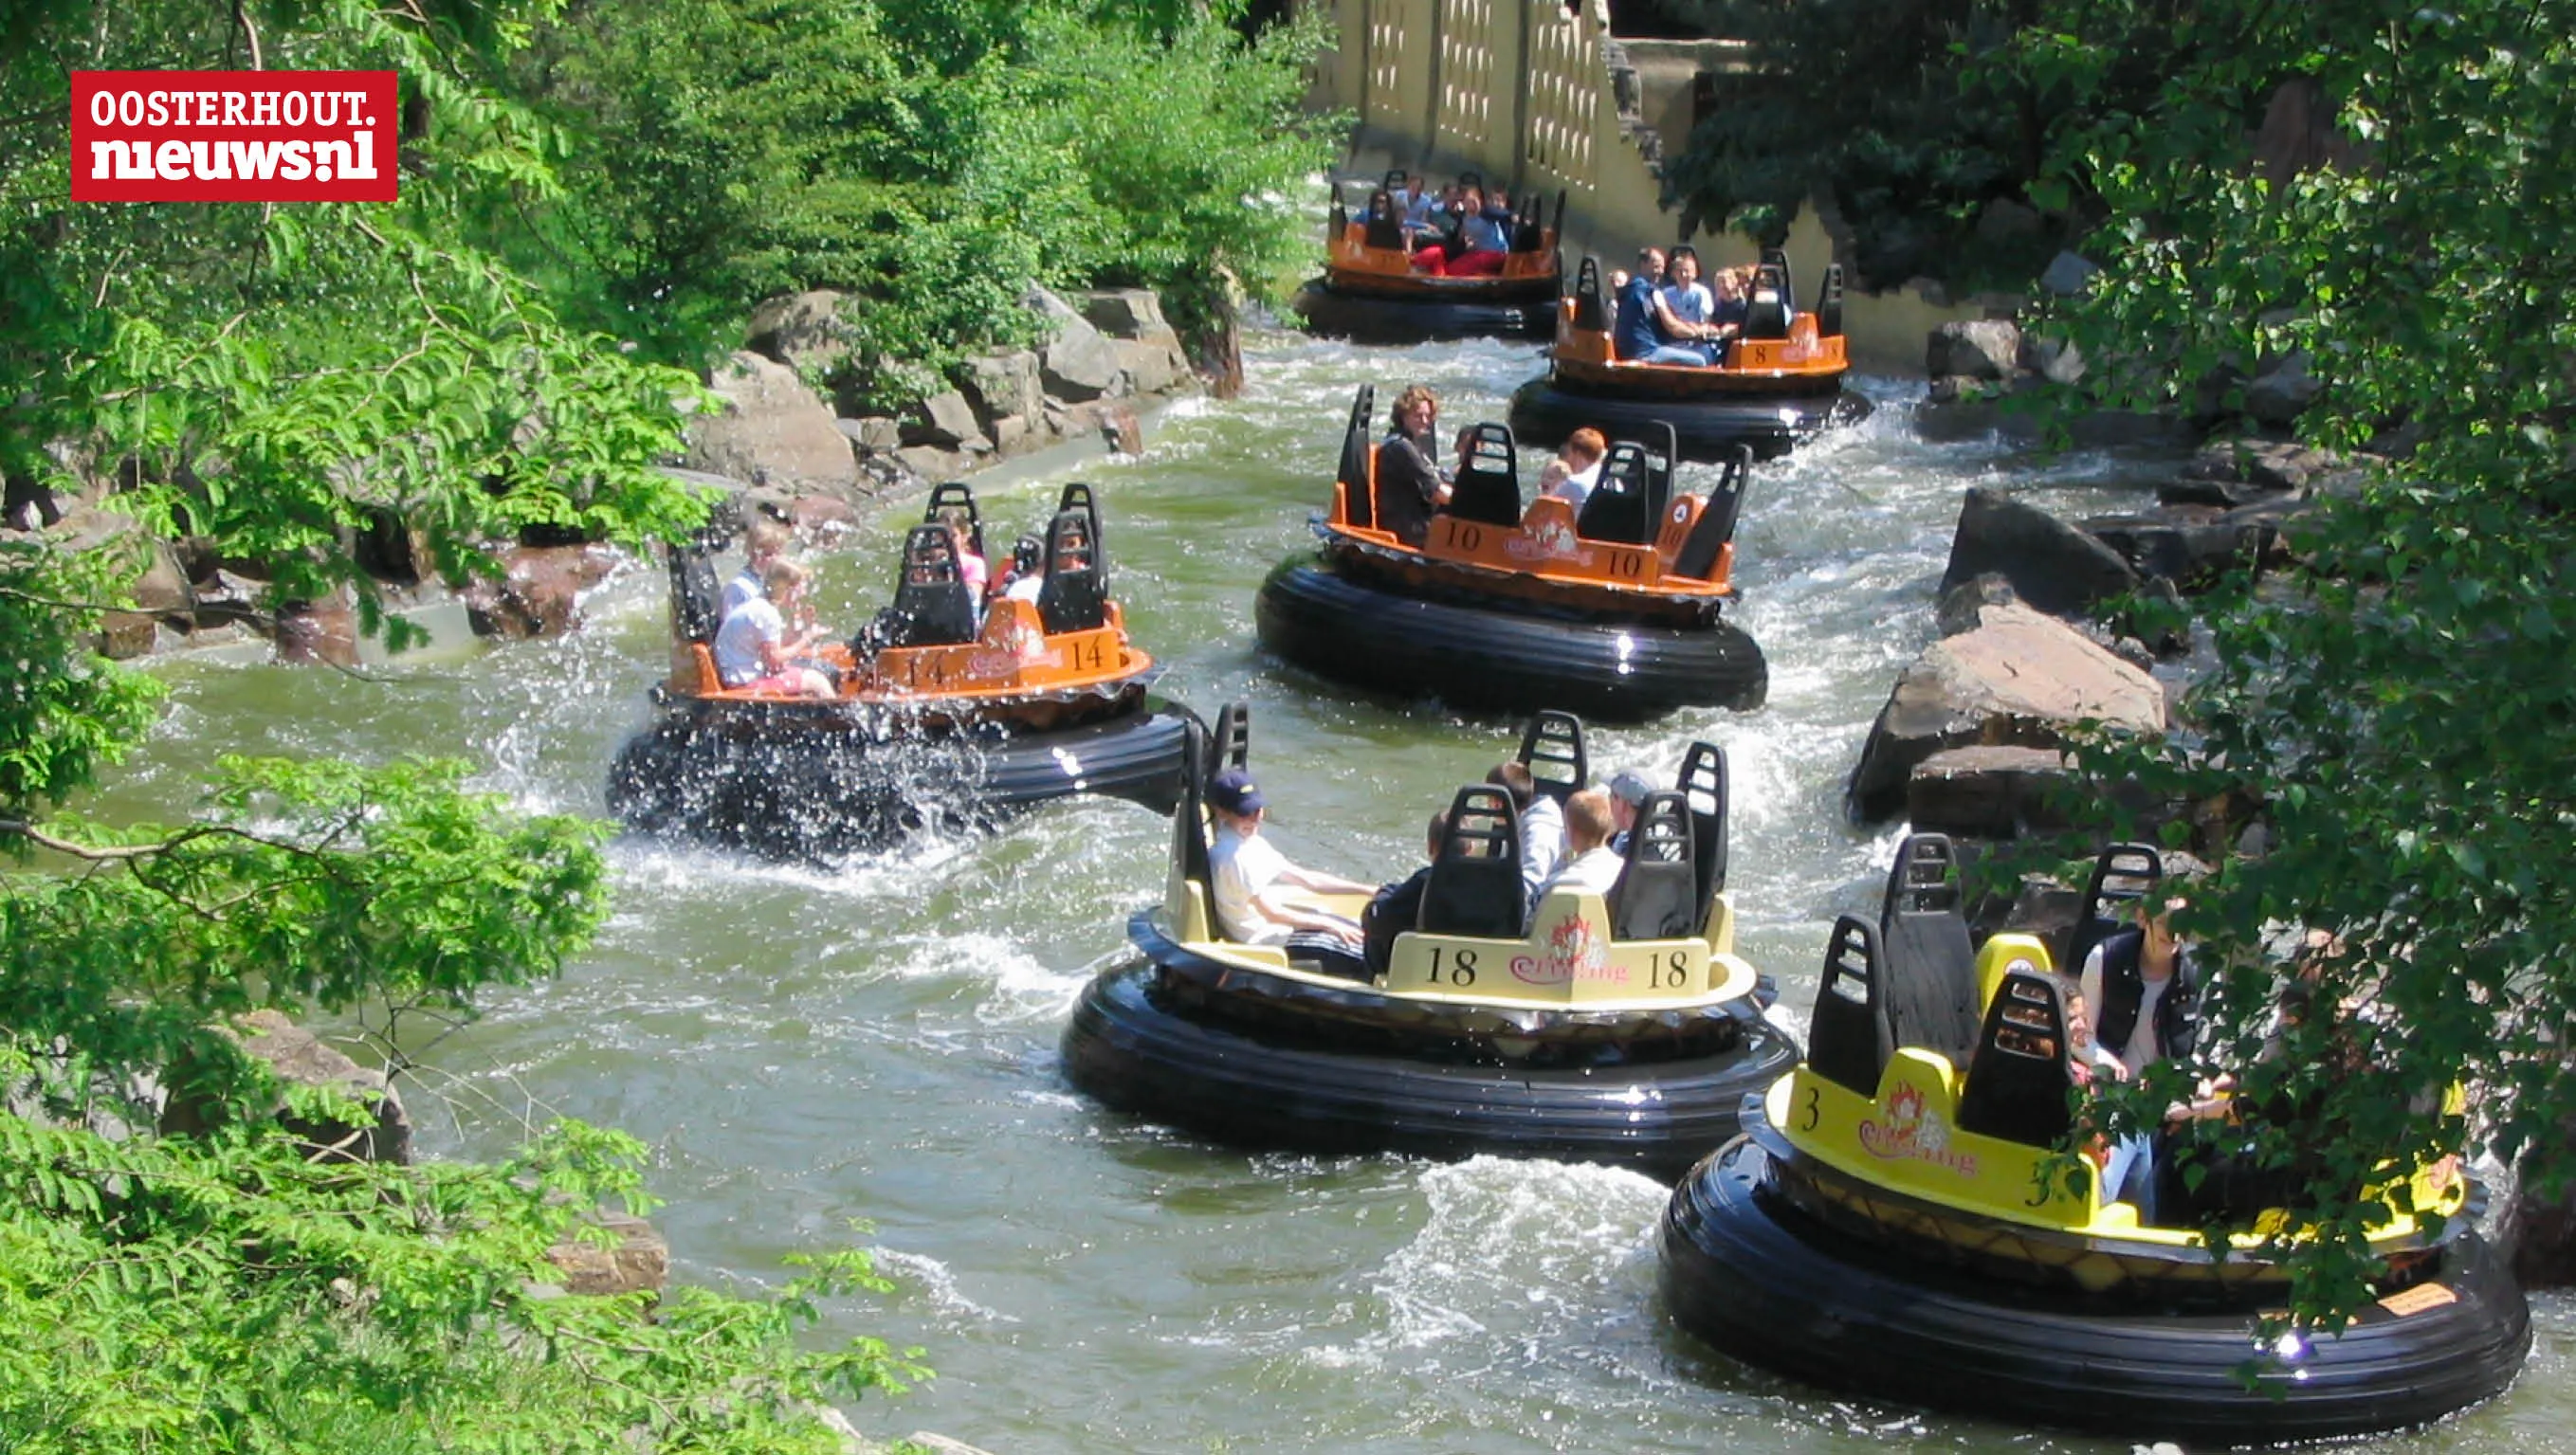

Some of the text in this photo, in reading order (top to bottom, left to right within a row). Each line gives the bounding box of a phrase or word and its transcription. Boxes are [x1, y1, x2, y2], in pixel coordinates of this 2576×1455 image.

[1755, 344, 1766, 365] 8
[1445, 521, 1482, 553] 10
[1608, 550, 1642, 578] 10
[1070, 633, 1103, 672] 14
[908, 658, 943, 687] 14
[1425, 946, 1478, 987] 18
[1647, 950, 1689, 990] 18
[1802, 1086, 1820, 1132] 3
